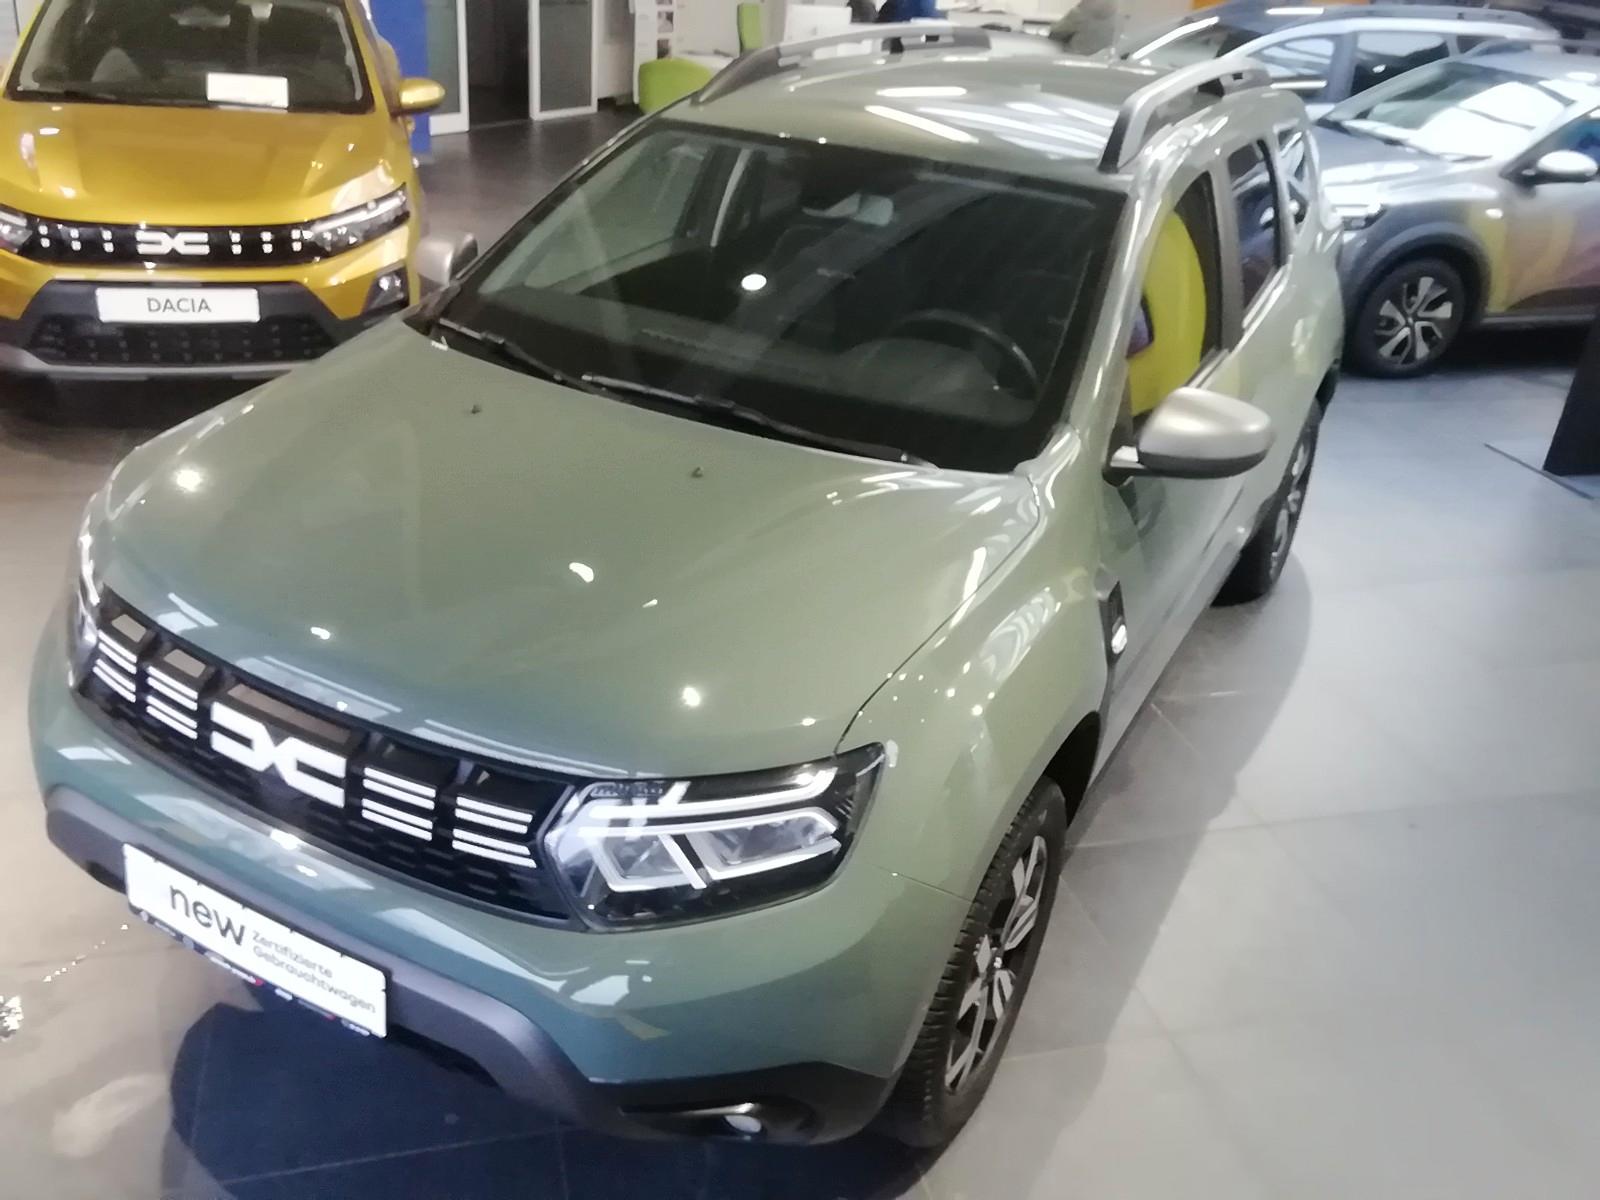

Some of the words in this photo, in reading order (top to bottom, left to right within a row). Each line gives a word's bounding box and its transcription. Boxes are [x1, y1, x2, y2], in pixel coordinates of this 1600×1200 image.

[147, 298, 211, 312] DACIA
[169, 884, 246, 946] new
[252, 930, 333, 979] Zertifizierte
[252, 944, 377, 1014] Gebrauchtwagen
